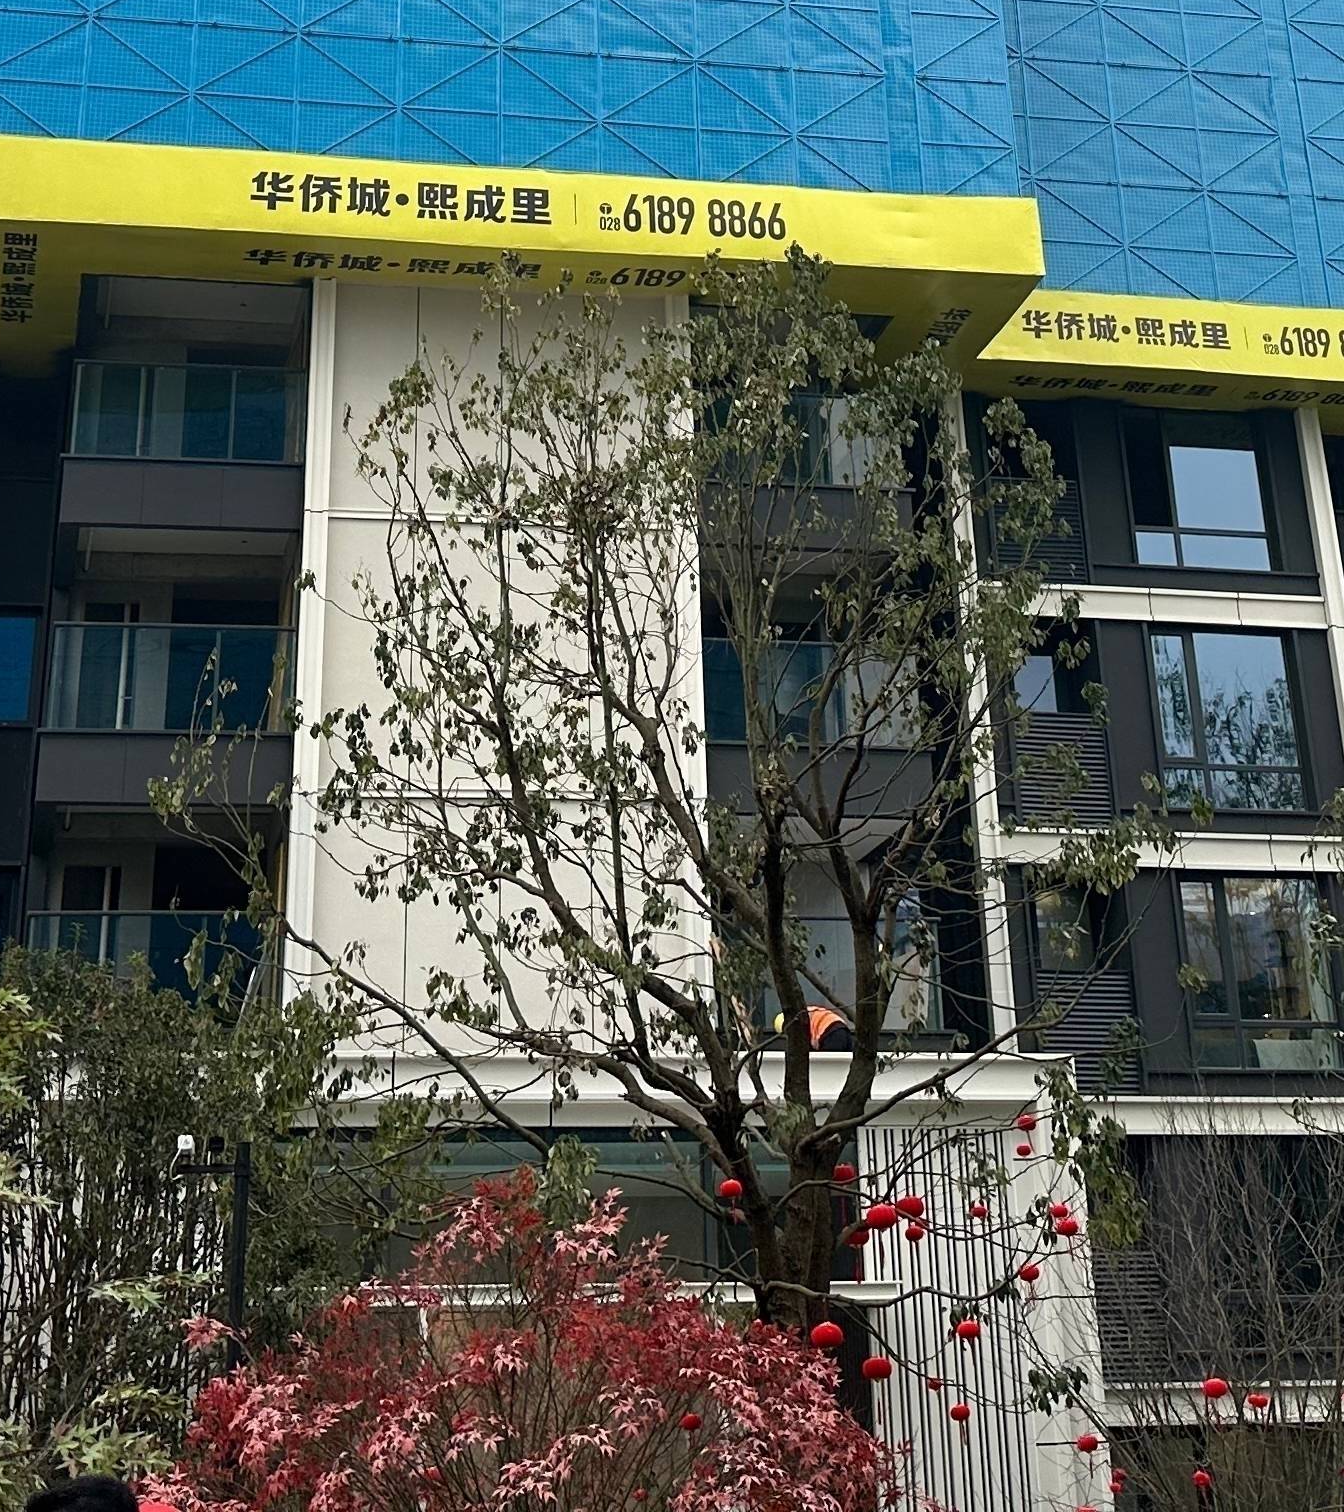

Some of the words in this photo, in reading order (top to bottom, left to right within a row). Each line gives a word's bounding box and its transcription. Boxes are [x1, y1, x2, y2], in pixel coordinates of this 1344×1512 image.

[249, 171, 553, 225] 华侨城·熙成里
[623, 193, 695, 236] 6189
[707, 198, 787, 241] 8866
[610, 267, 686, 287] 6189
[1021, 309, 1232, 350] 华侨城·熙成里
[1280, 326, 1331, 358] 6189
[1262, 389, 1320, 403] 6189
